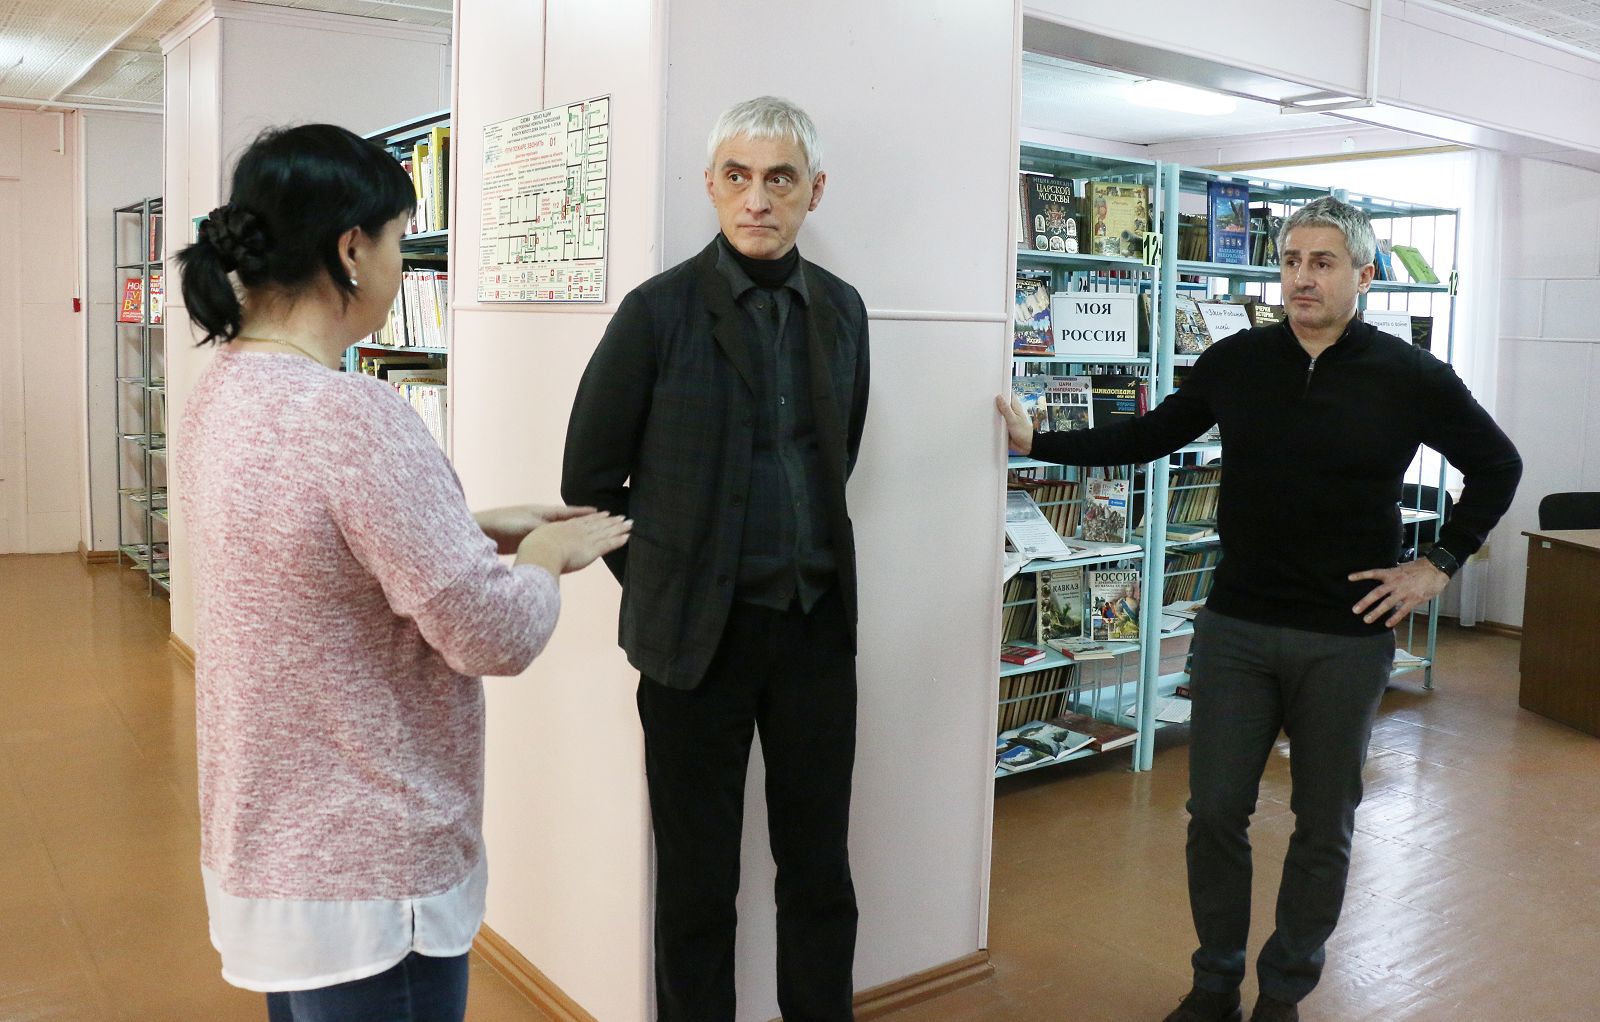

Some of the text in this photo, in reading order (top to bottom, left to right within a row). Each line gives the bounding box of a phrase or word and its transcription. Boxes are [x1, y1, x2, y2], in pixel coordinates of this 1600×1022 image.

[550, 136, 556, 147] 01
[1036, 182, 1071, 196] ЦАРСКОЙ
[1038, 192, 1070, 204] МОСКВЫ
[1076, 302, 1112, 315] МОЯ
[1062, 329, 1126, 342] РОССИЯ
[1095, 572, 1137, 582] РОССИЯ
[1052, 583, 1079, 592] КАВКАЗ
